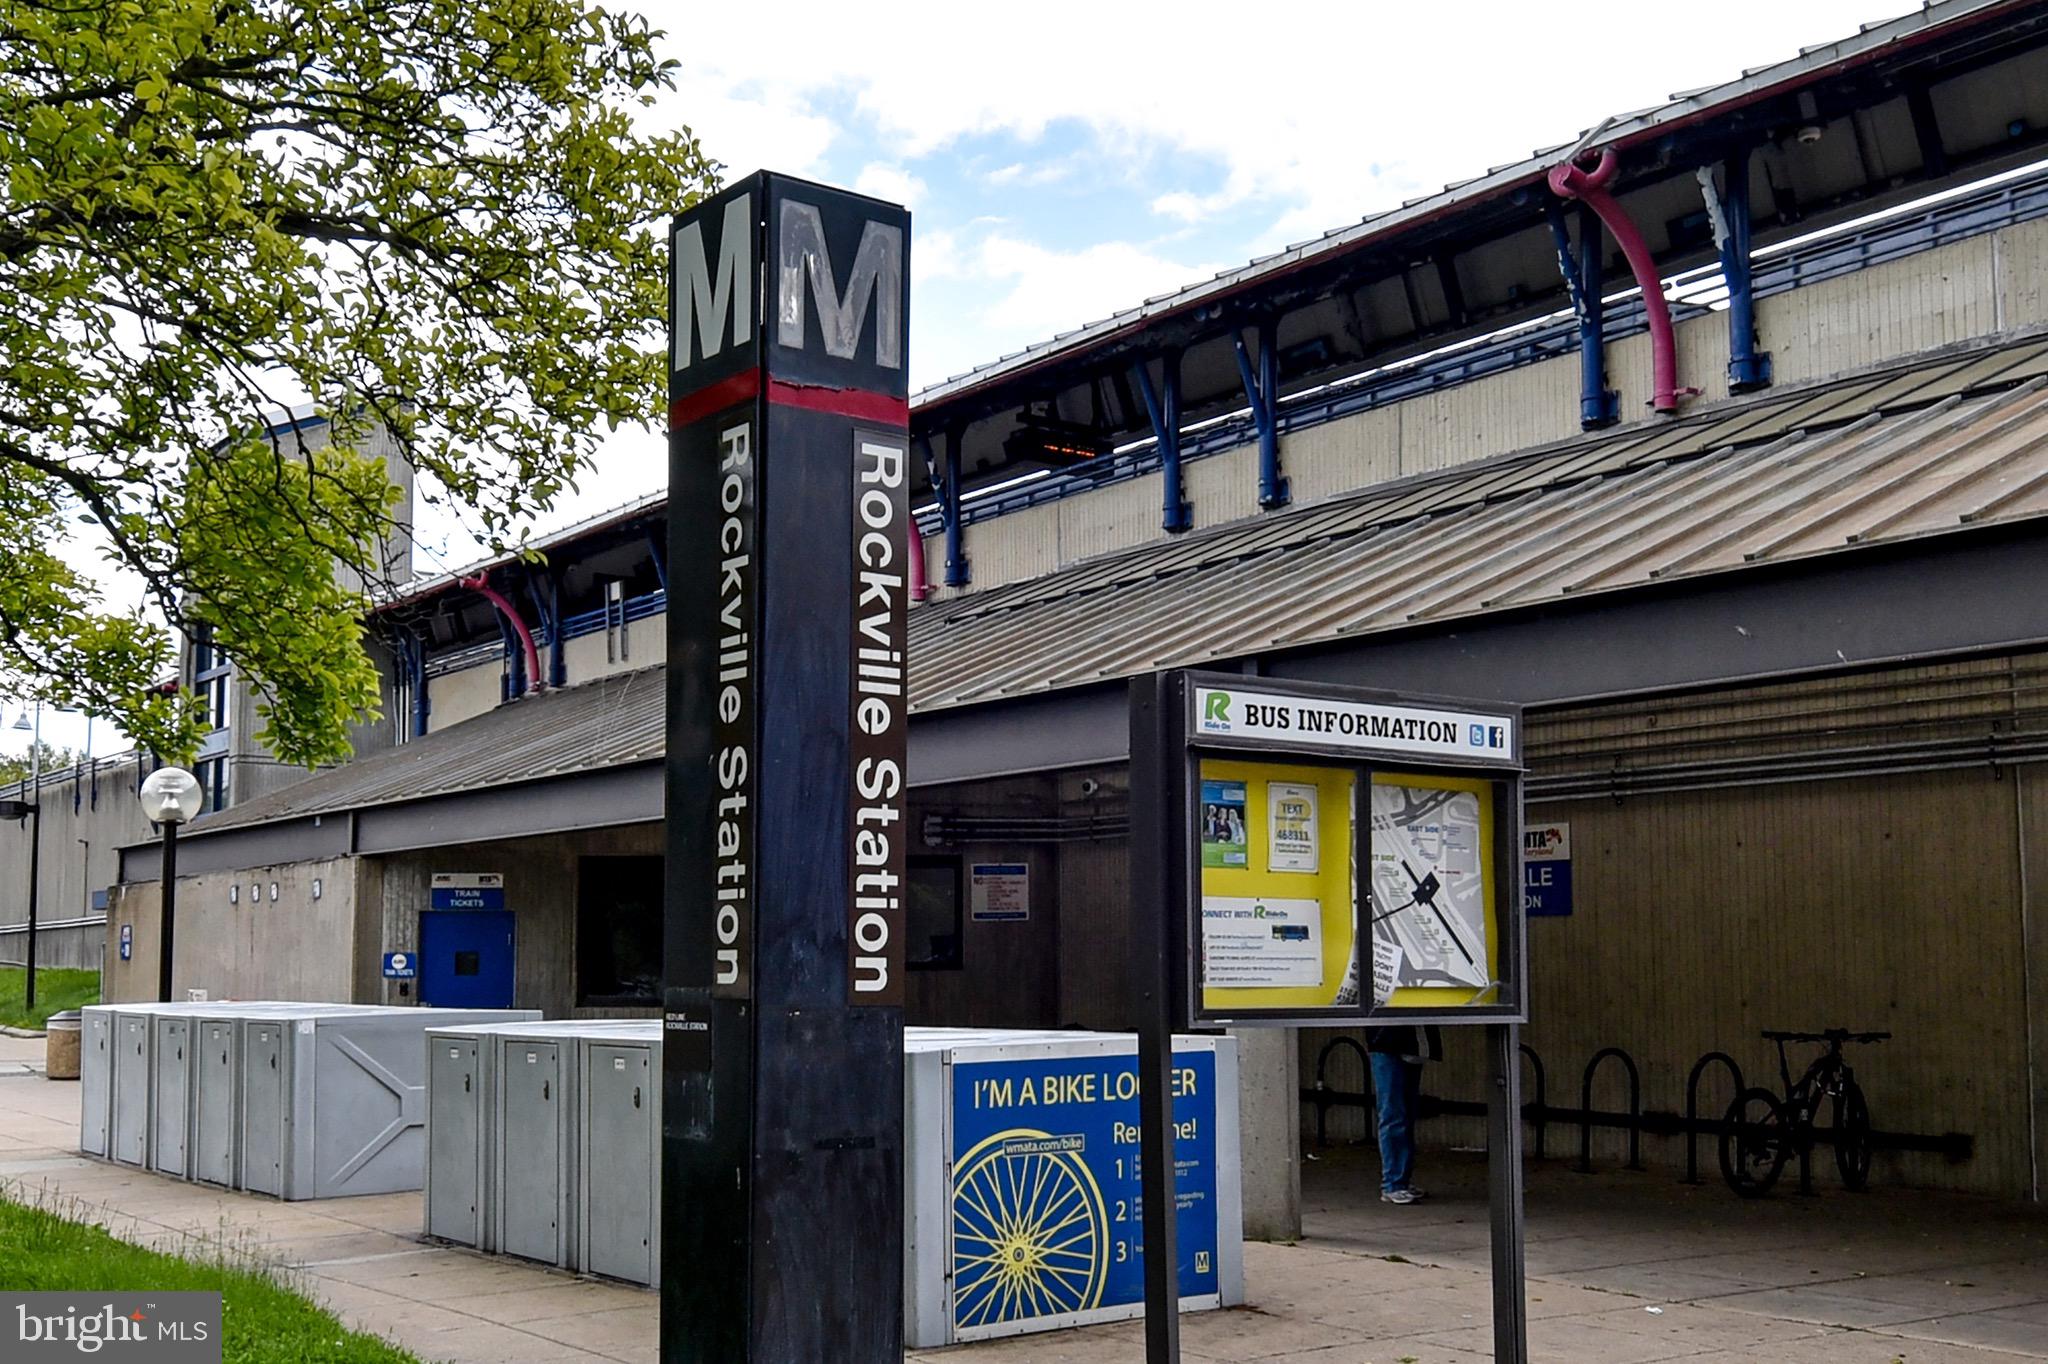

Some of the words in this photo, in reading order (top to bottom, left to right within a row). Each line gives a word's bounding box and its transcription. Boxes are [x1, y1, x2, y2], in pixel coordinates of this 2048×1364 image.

[675, 192, 751, 372] M
[778, 198, 902, 369] M
[718, 421, 750, 724] Rockville
[857, 442, 903, 735] Rockville
[1245, 704, 1290, 729] BUS
[1298, 709, 1457, 743] INFORMATION
[1281, 803, 1304, 815] TEXT
[1424, 825, 1439, 833] SIDE
[716, 746, 748, 985] Station
[854, 757, 901, 992] Station
[450, 899, 484, 907] TICKETS
[455, 889, 480, 897] TRAIN
[1202, 909, 1232, 918] ONNECT
[975, 1078, 1013, 1109] I'M
[1018, 1077, 1037, 1107] A
[1043, 1073, 1096, 1105] BIKE
[1103, 1068, 1196, 1101] LOER
[1005, 1137, 1082, 1154] wmata.com/bike
[1115, 1158, 1123, 1179] 1
[1115, 1200, 1126, 1221] 2
[1116, 1241, 1126, 1262] 3
